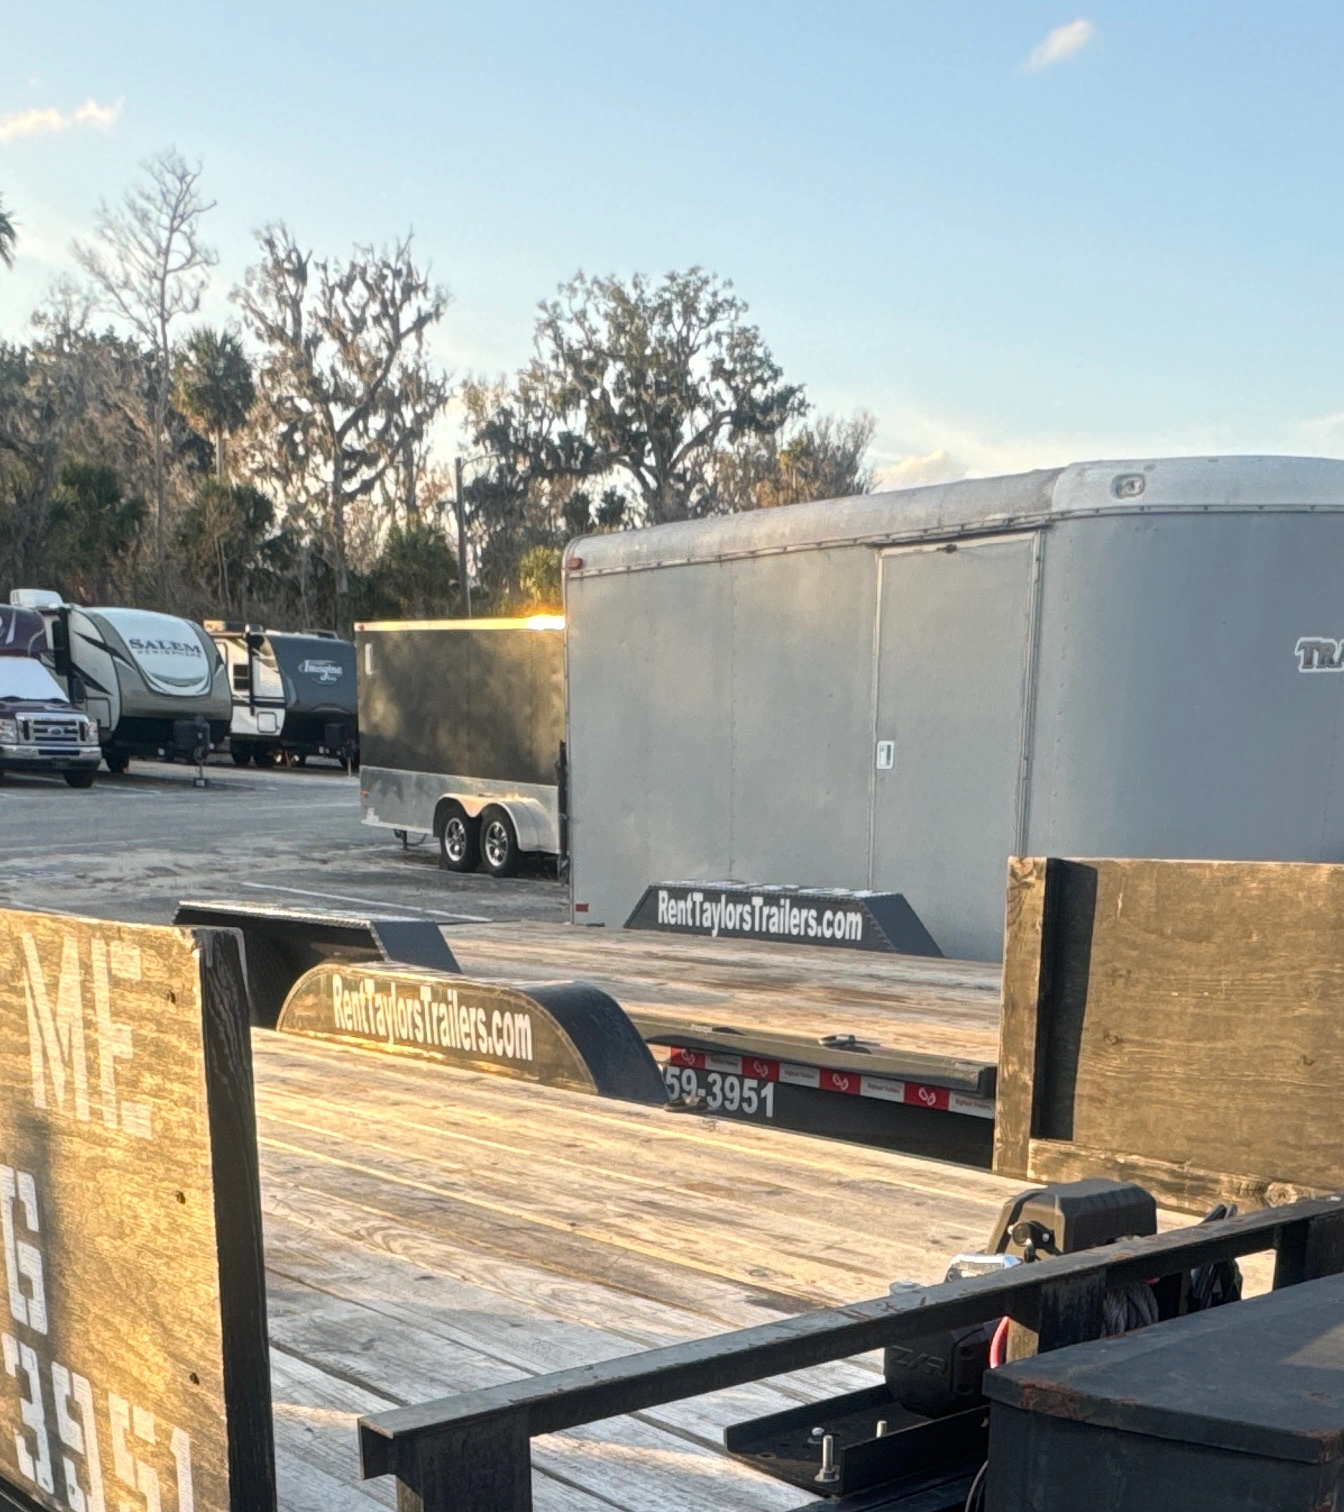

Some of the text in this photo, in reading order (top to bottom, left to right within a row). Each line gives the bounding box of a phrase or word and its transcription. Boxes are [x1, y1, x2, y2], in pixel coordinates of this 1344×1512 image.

[128, 638, 202, 655] SALEM
[658, 889, 863, 942] RentTaylorsTrailers.com
[21, 931, 154, 1140] ME
[332, 973, 534, 1062] RentTaylorsTrailers.com
[657, 1064, 774, 1118] 59-3951
